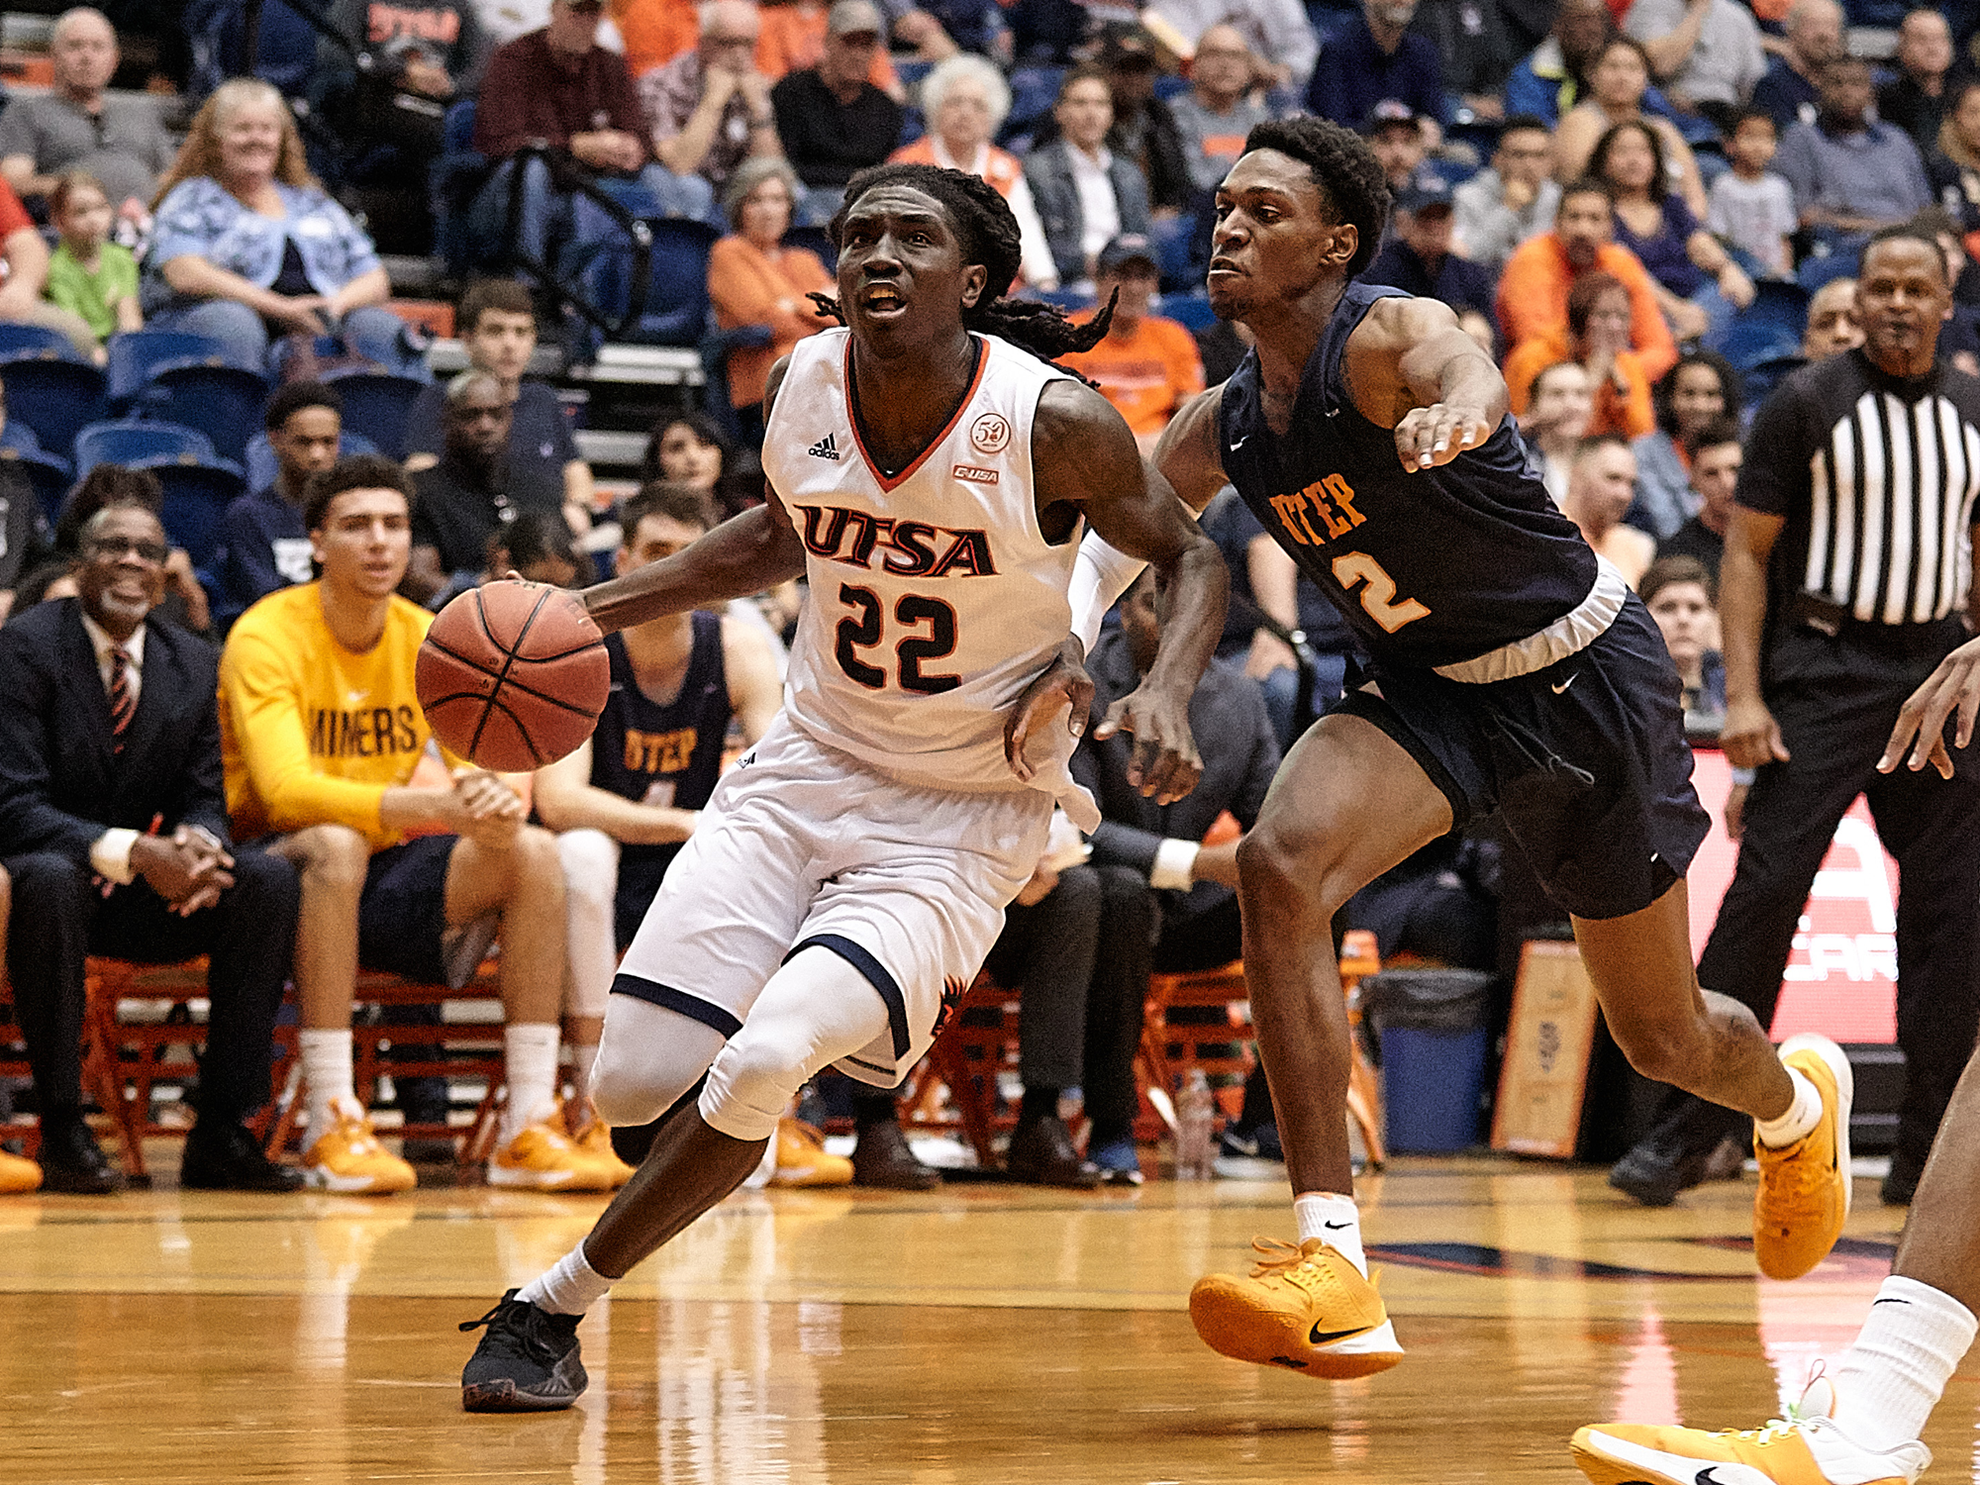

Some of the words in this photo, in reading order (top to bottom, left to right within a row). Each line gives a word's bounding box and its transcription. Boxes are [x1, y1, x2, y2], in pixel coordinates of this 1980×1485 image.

[808, 447, 840, 461] adidas
[792, 503, 1002, 579] UTSA
[1331, 550, 1432, 634] 2
[834, 582, 962, 696] 22
